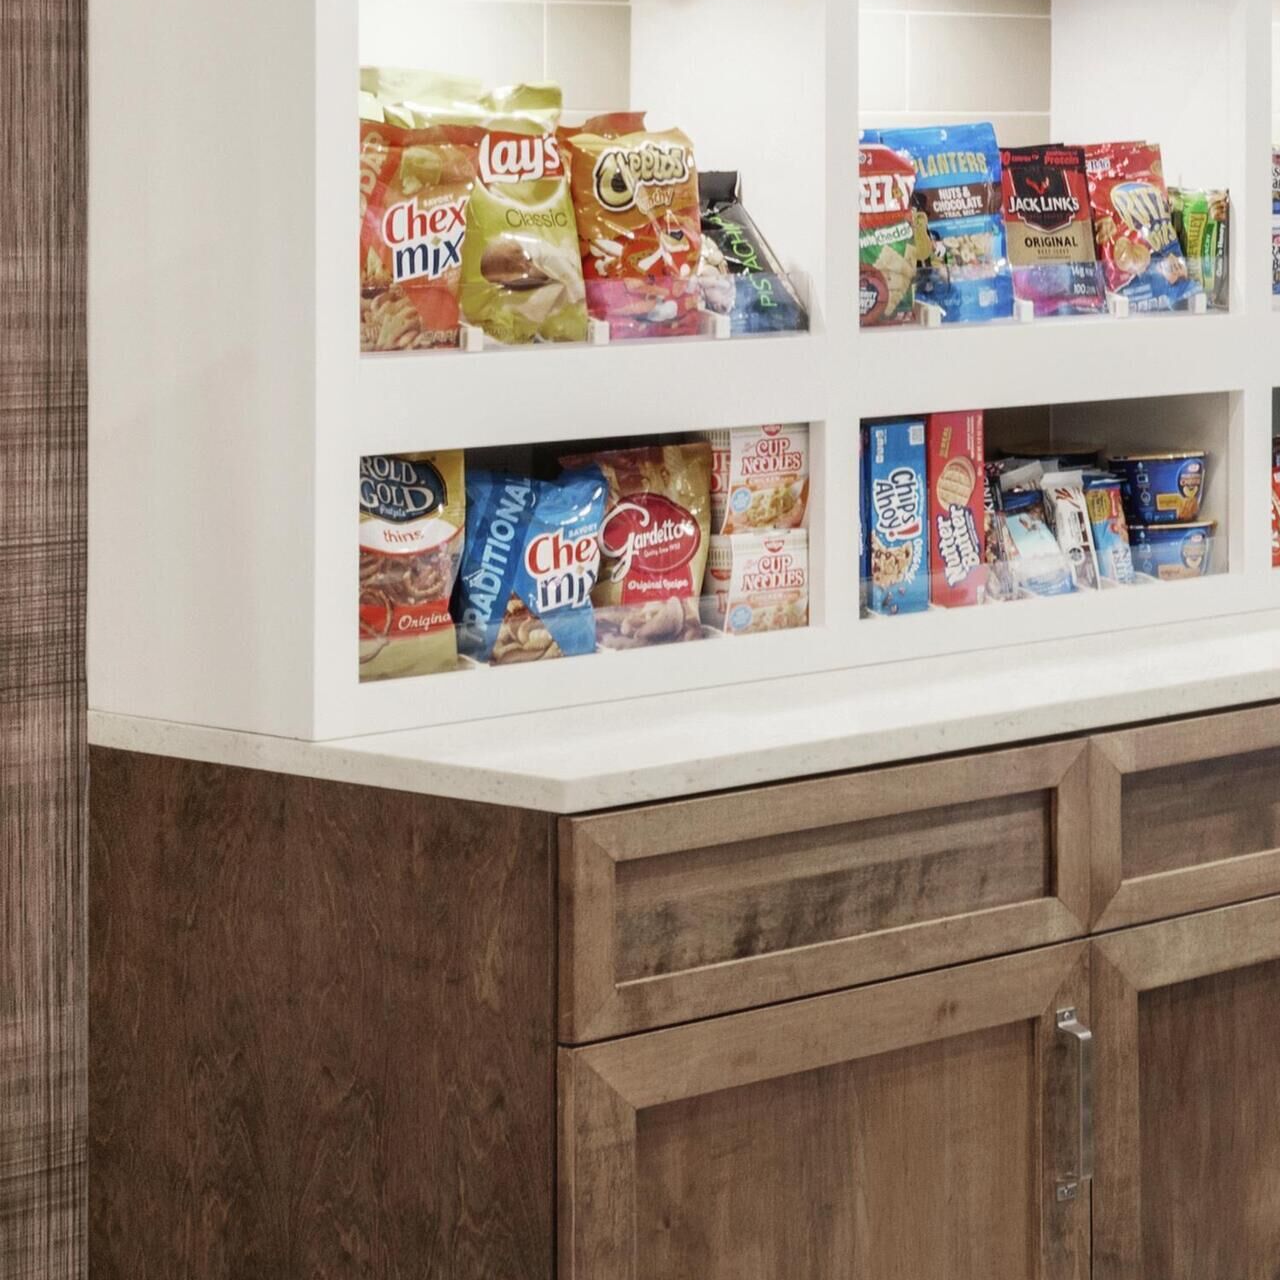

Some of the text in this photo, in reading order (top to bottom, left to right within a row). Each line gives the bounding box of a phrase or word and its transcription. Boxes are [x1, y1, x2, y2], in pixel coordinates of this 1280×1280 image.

[479, 133, 560, 184] Lay's
[938, 188, 961, 200] NUTS
[932, 196, 984, 214] CHOCOLATE
[1008, 196, 1040, 214] JACK
[385, 198, 467, 244] Chex
[505, 209, 568, 229] Classic
[1024, 236, 1078, 249] ORIGINAL
[396, 232, 464, 279] mix
[756, 439, 790, 458] CUP
[741, 452, 802, 475] NOODLES
[360, 476, 435, 513] GOLD
[890, 470, 917, 525] Chips
[758, 556, 793, 574] CUP
[628, 579, 689, 592] Original Recipe
[741, 571, 804, 592] NOODLES
